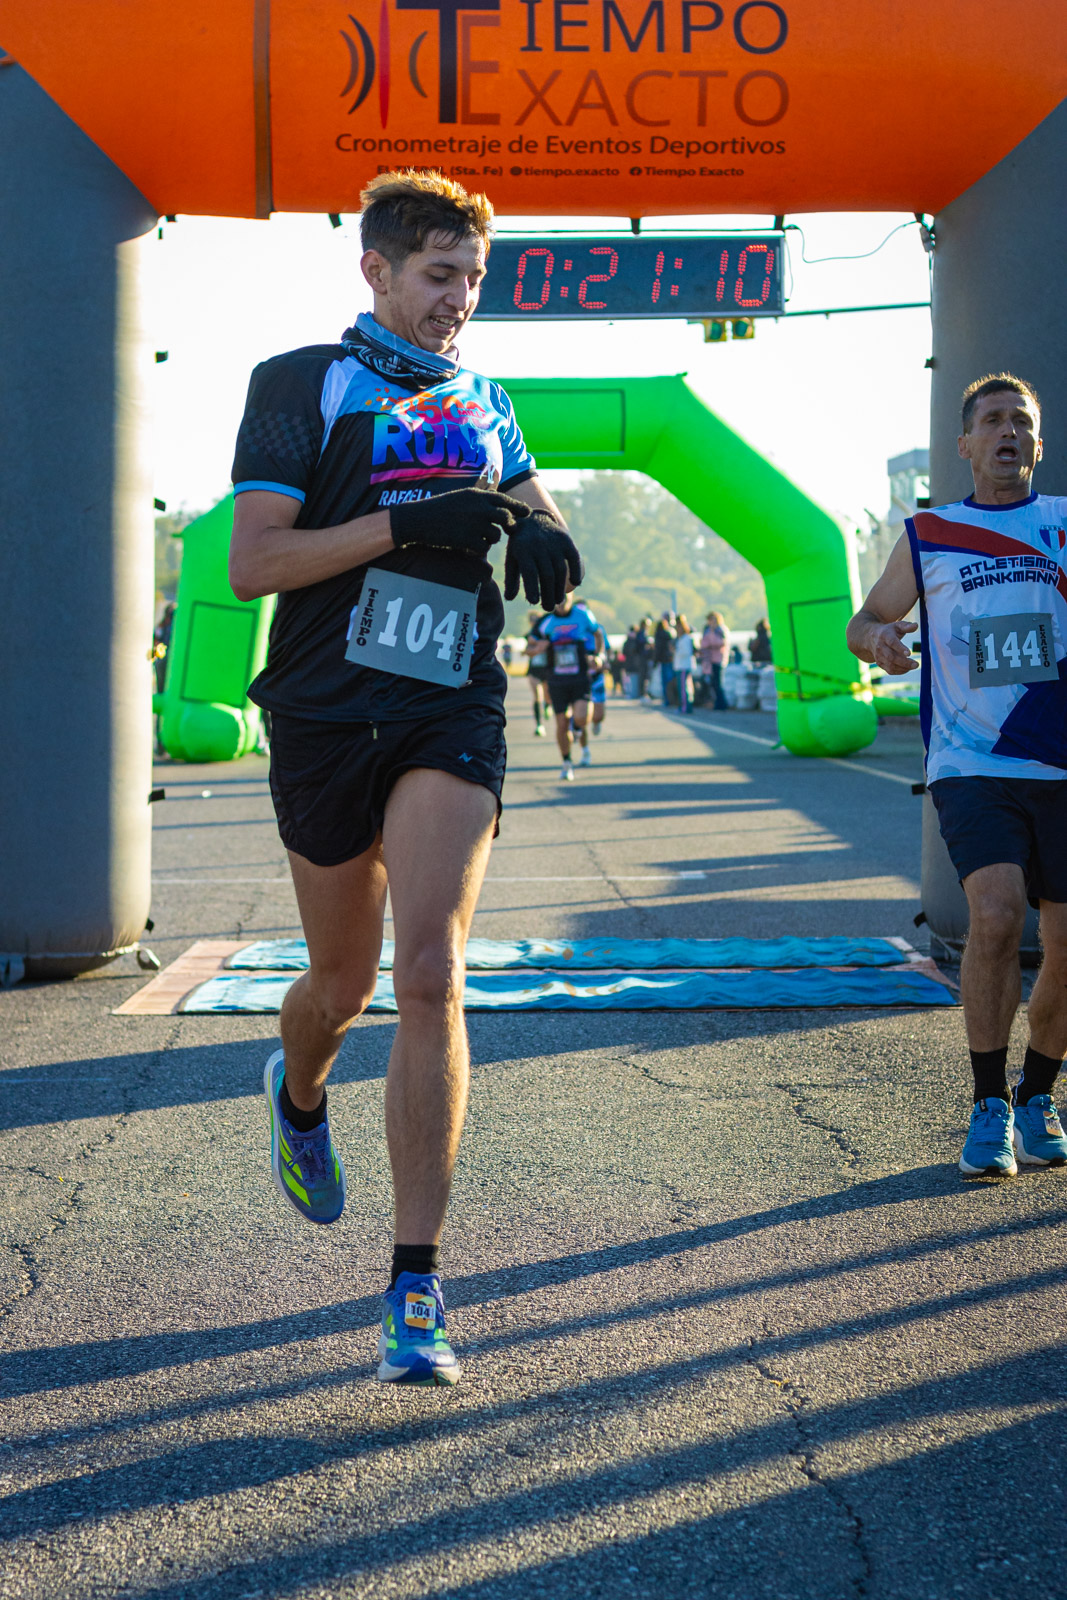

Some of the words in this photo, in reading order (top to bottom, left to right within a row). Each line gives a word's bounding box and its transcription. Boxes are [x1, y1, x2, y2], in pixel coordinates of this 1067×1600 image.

[335, 133, 501, 157] Cronometraje
[508, 135, 538, 153] de
[546, 135, 642, 154] Eventos
[650, 135, 786, 158] Deportivos
[451, 166, 480, 177] (Sta.
[483, 166, 503, 177] Fe)
[524, 165, 619, 177] tiempo.exacto
[644, 166, 696, 177] Tiempo
[699, 166, 744, 176] Exacto
[513, 244, 774, 310] 0:21:10
[372, 414, 488, 468] RUN
[959, 556, 1058, 579] ATLETISMO
[961, 569, 1060, 593] BRINKMANN
[356, 588, 379, 646] TIEMPO
[377, 597, 458, 661] 104
[452, 613, 470, 672] EXACTO
[974, 631, 984, 673] TIEMPO
[984, 630, 1042, 669] 144
[1039, 624, 1050, 668] EXACTO
[411, 1304, 430, 1318] 104
